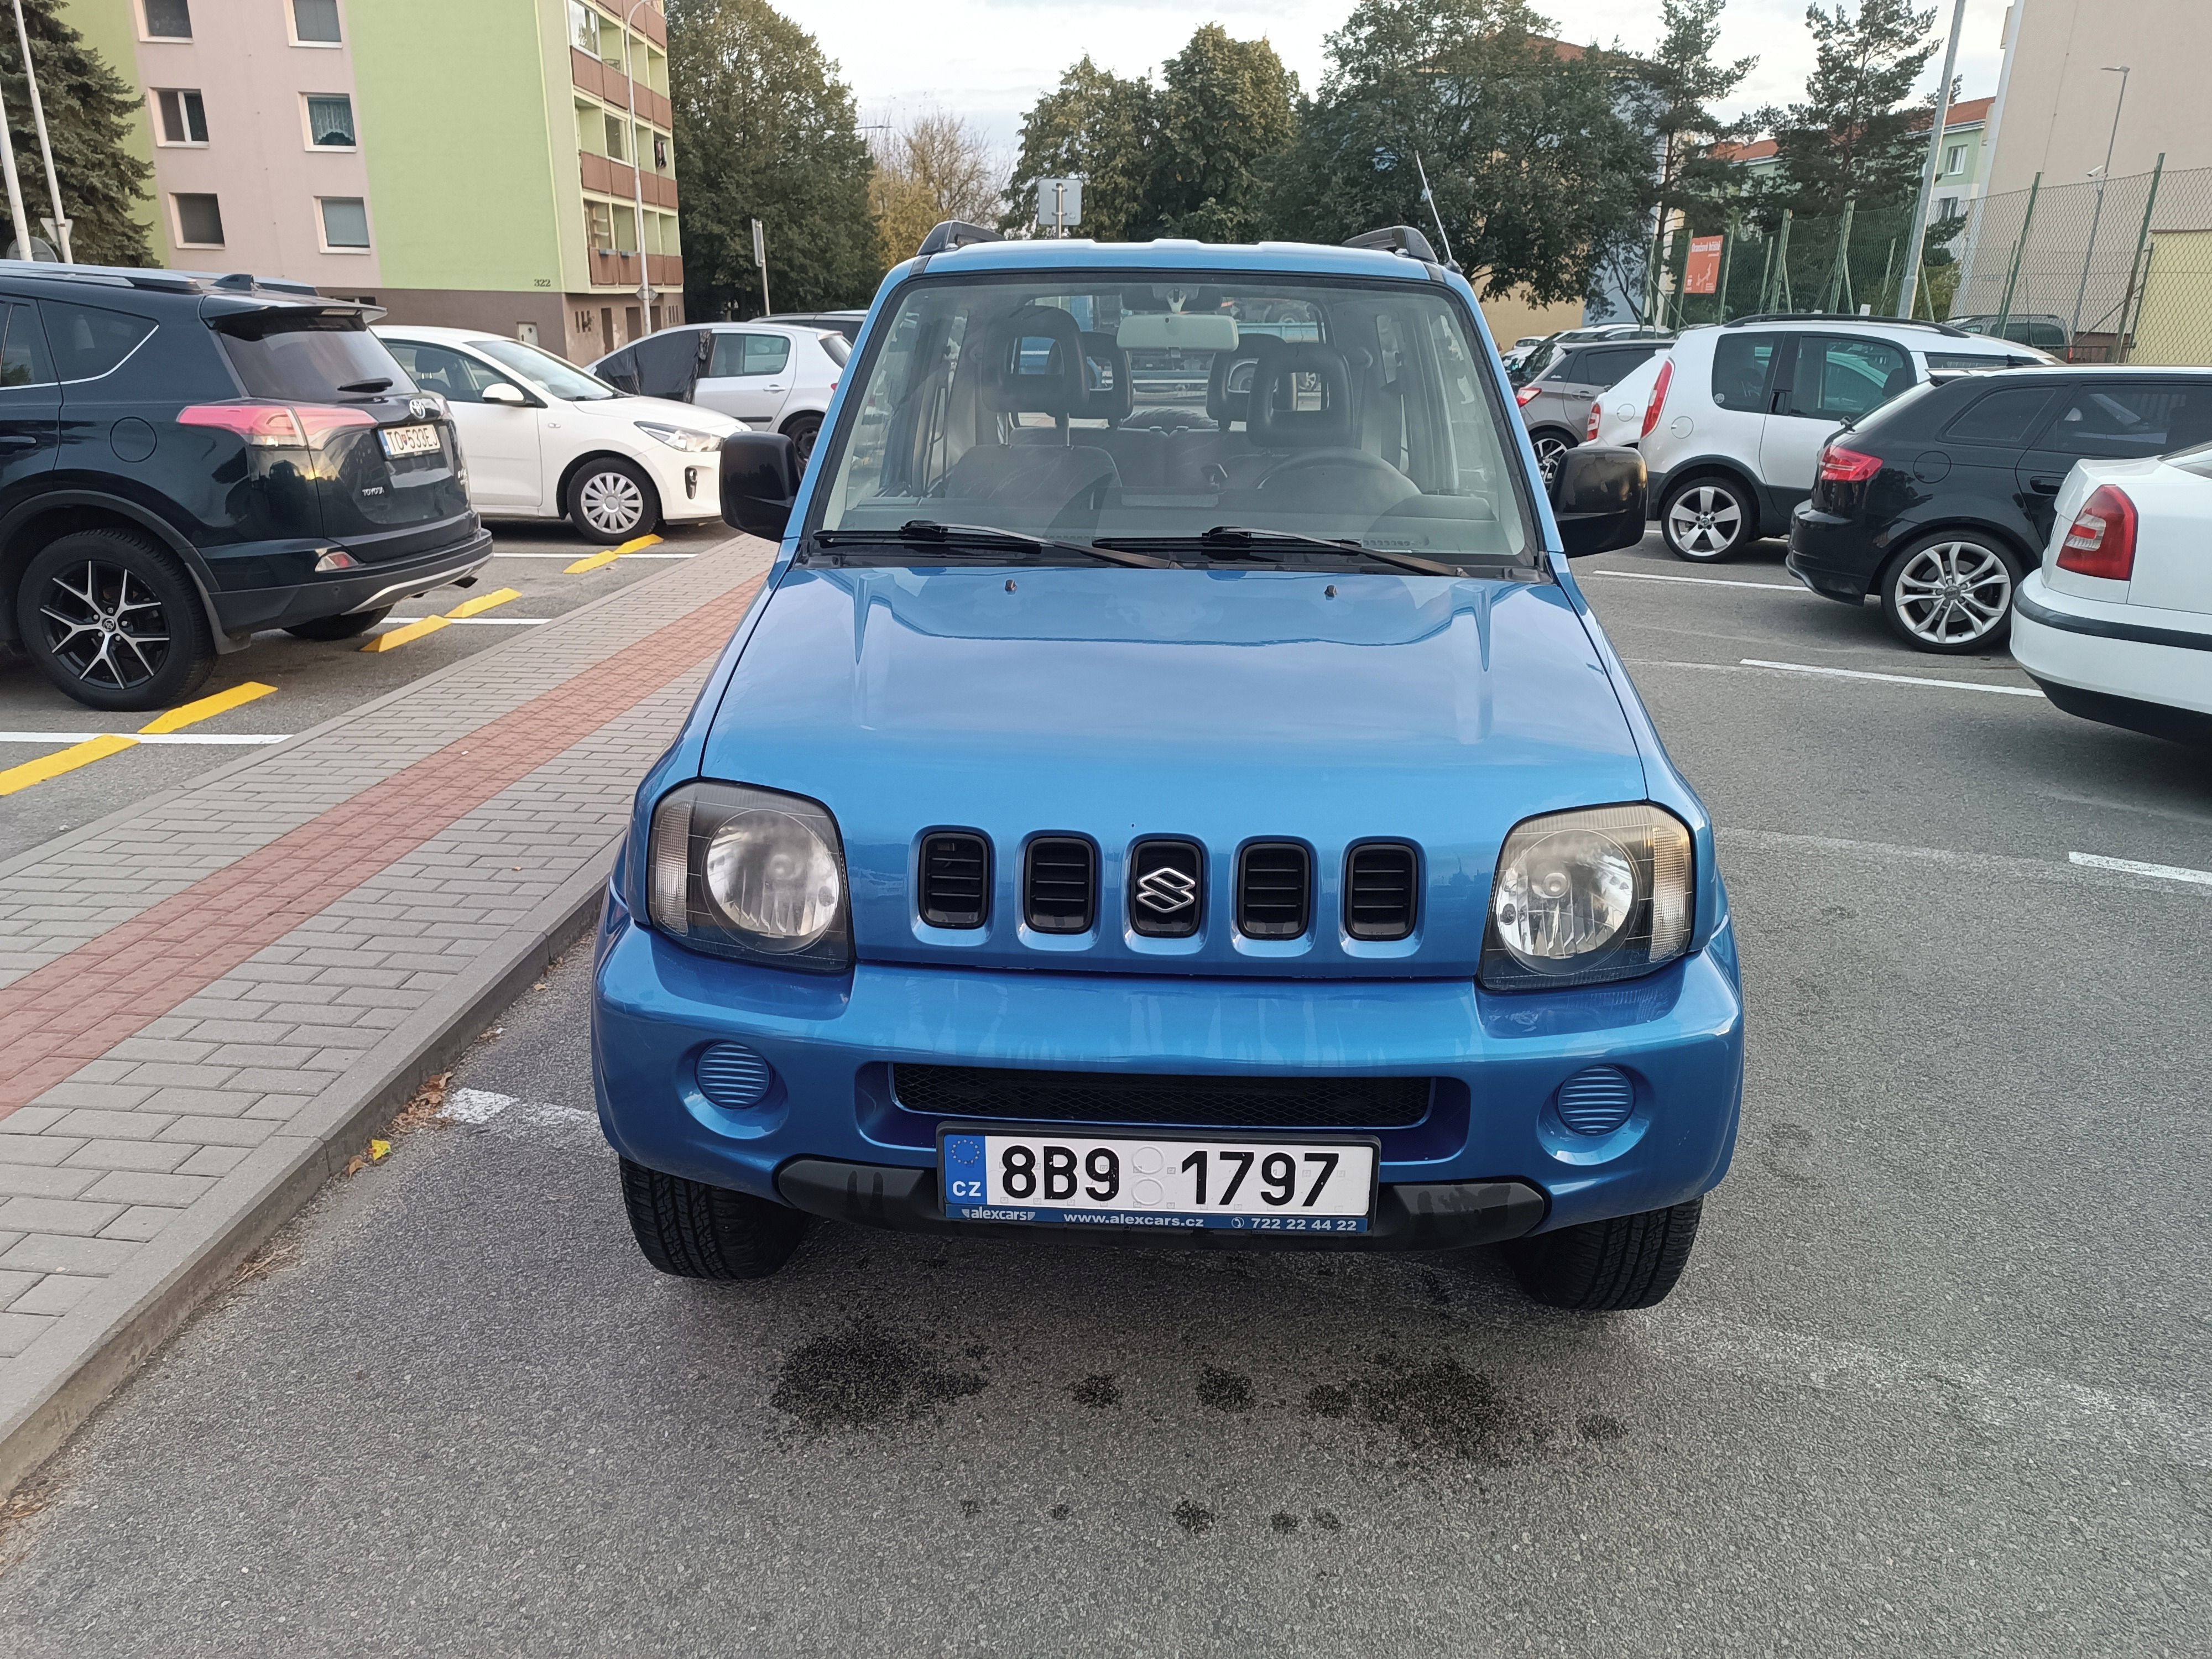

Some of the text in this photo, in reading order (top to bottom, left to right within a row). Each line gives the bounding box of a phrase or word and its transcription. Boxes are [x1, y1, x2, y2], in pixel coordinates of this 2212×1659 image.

[534, 279, 551, 287] 322
[387, 431, 404, 452] TO
[362, 486, 385, 497] TOYOTA
[1002, 1145, 1339, 1207] 8B9 1797
[952, 1181, 982, 1197] CZ
[971, 1206, 1027, 1220] alexcars
[1063, 1213, 1204, 1227] www.alexcars.cz
[1251, 1218, 1357, 1231] 722 22 44 22
